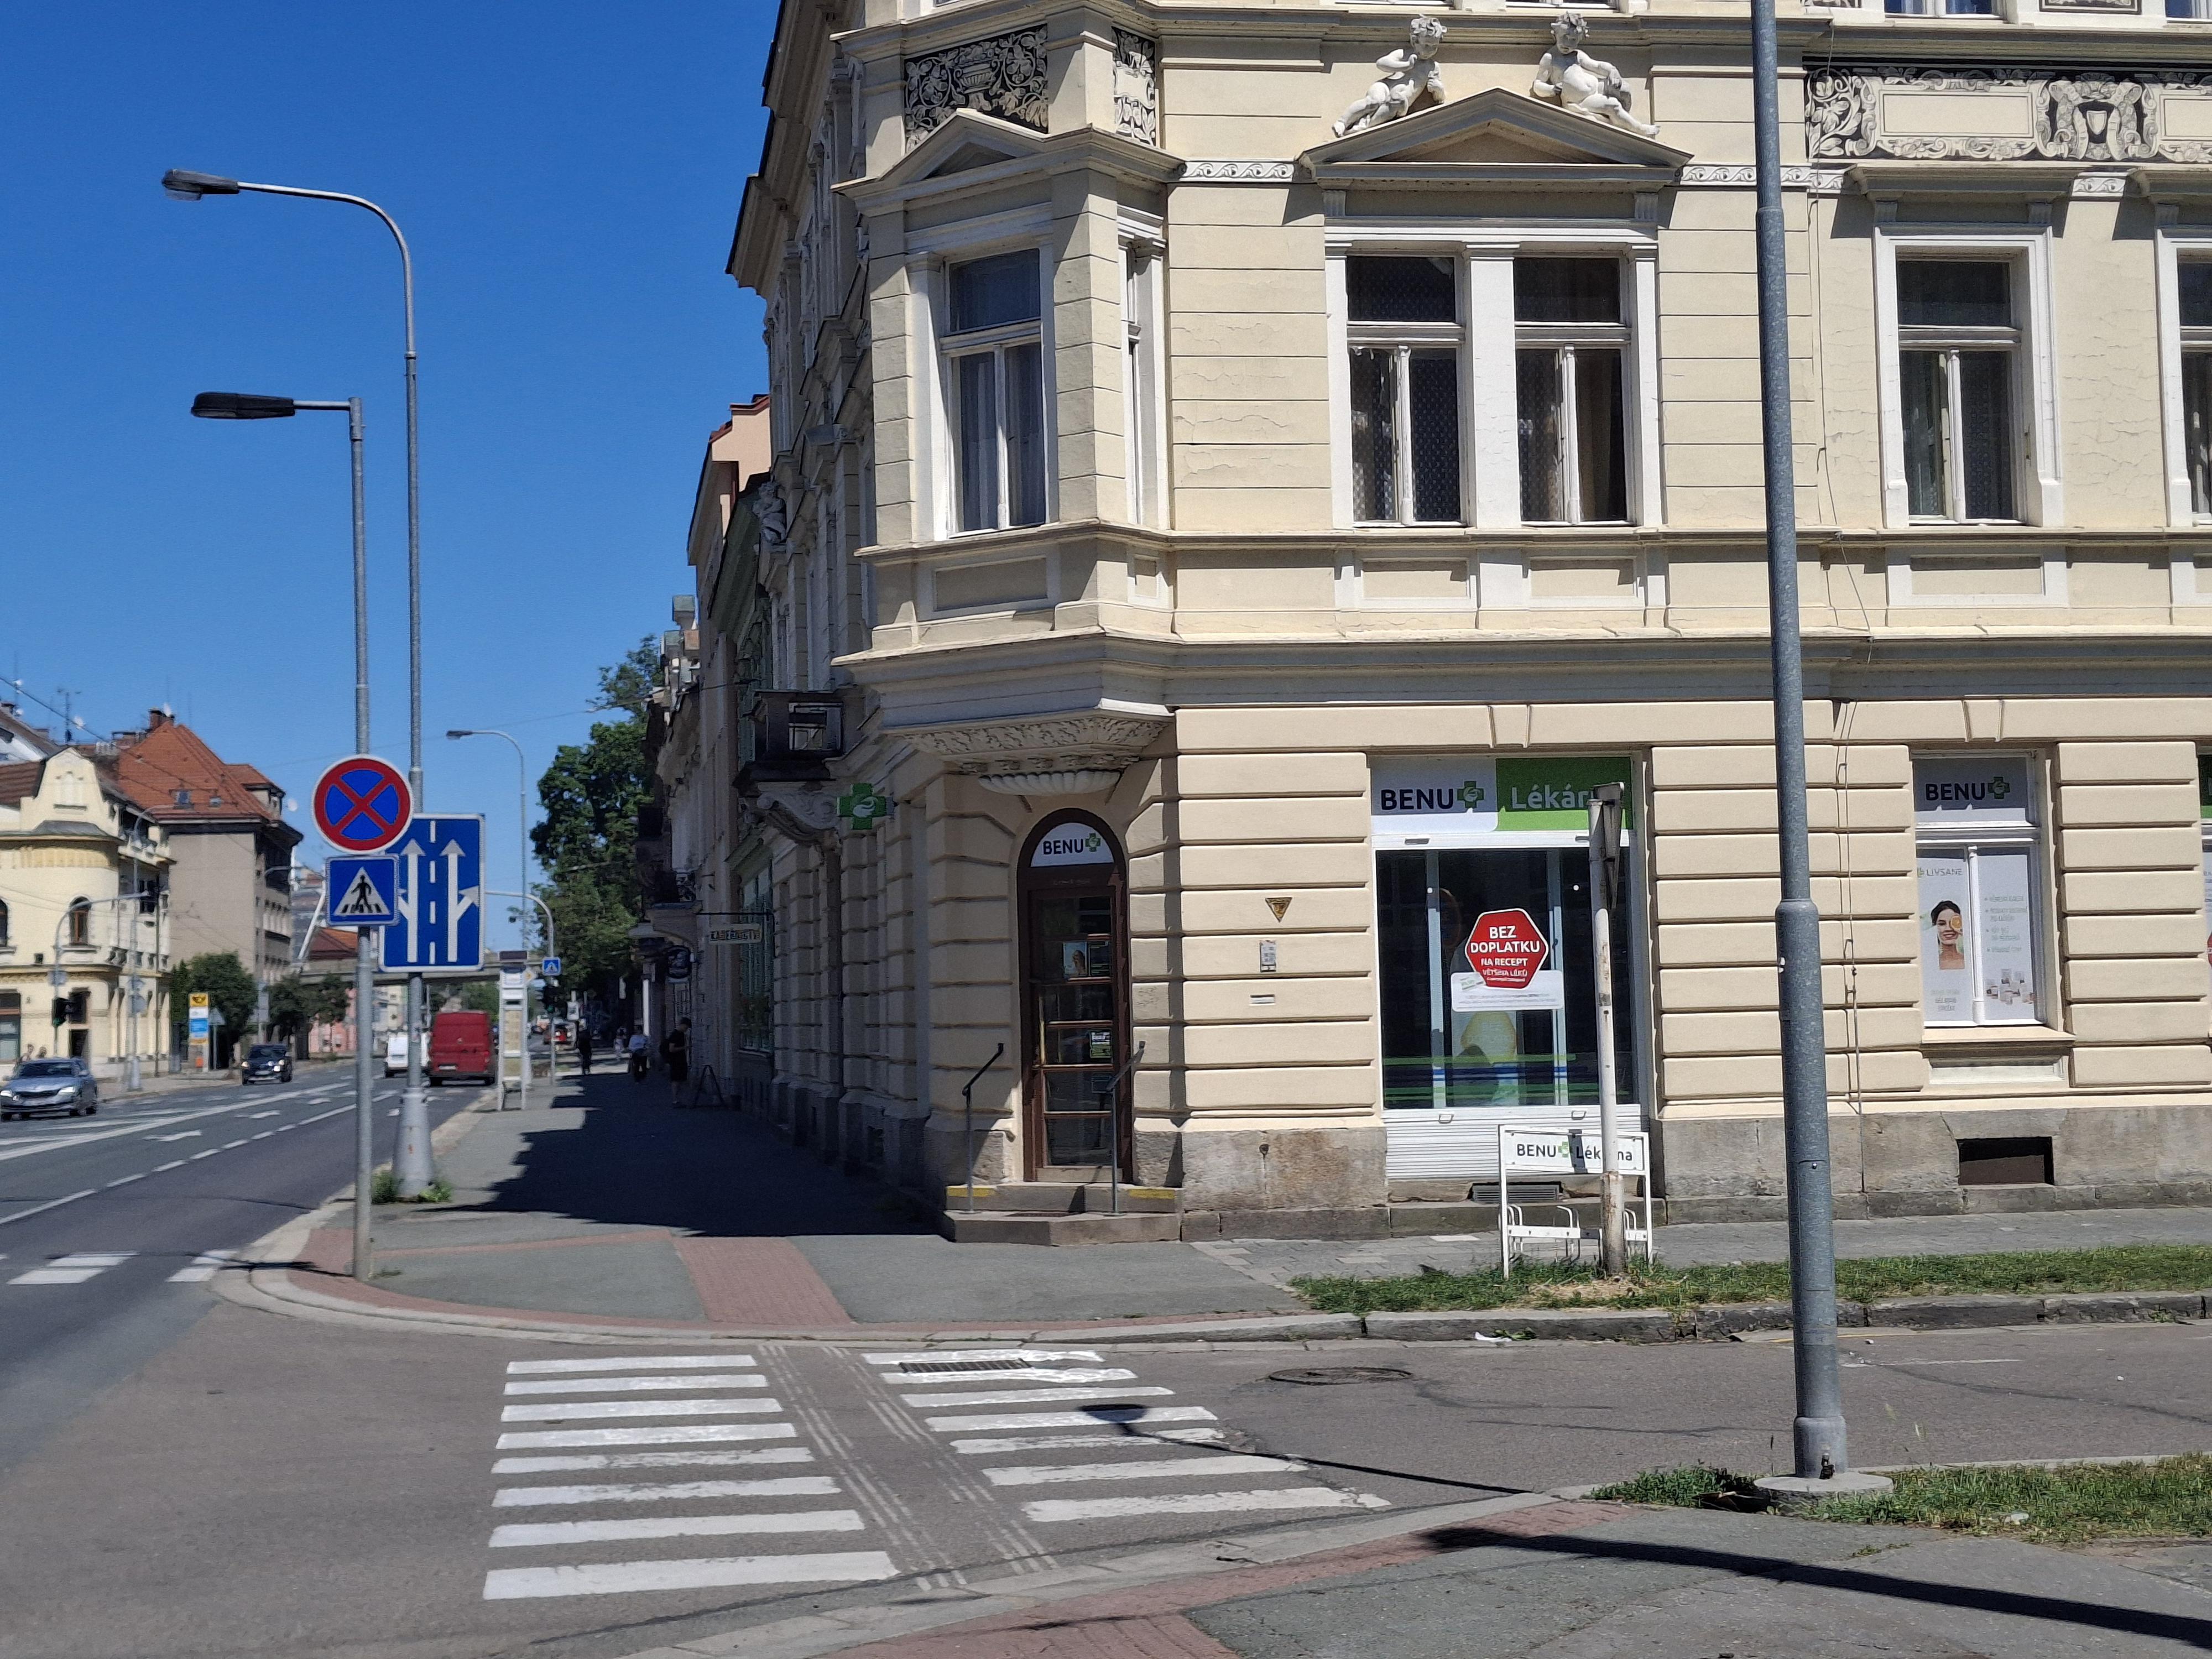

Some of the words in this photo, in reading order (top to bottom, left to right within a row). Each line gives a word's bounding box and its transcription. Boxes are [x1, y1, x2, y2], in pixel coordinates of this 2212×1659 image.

[1381, 789, 1454, 810] BENU
[1511, 784, 1595, 809] Lékár
[1925, 782, 1986, 801] BENU
[1043, 838, 1084, 855] BENU
[1489, 925, 1517, 939] BEZ
[1470, 940, 1541, 953] DOPLATKU
[1480, 958, 1494, 967] NA
[1495, 958, 1528, 967] RECEPT
[1517, 1143, 1557, 1157] BENU
[1576, 1145, 1632, 1161] Lékna
